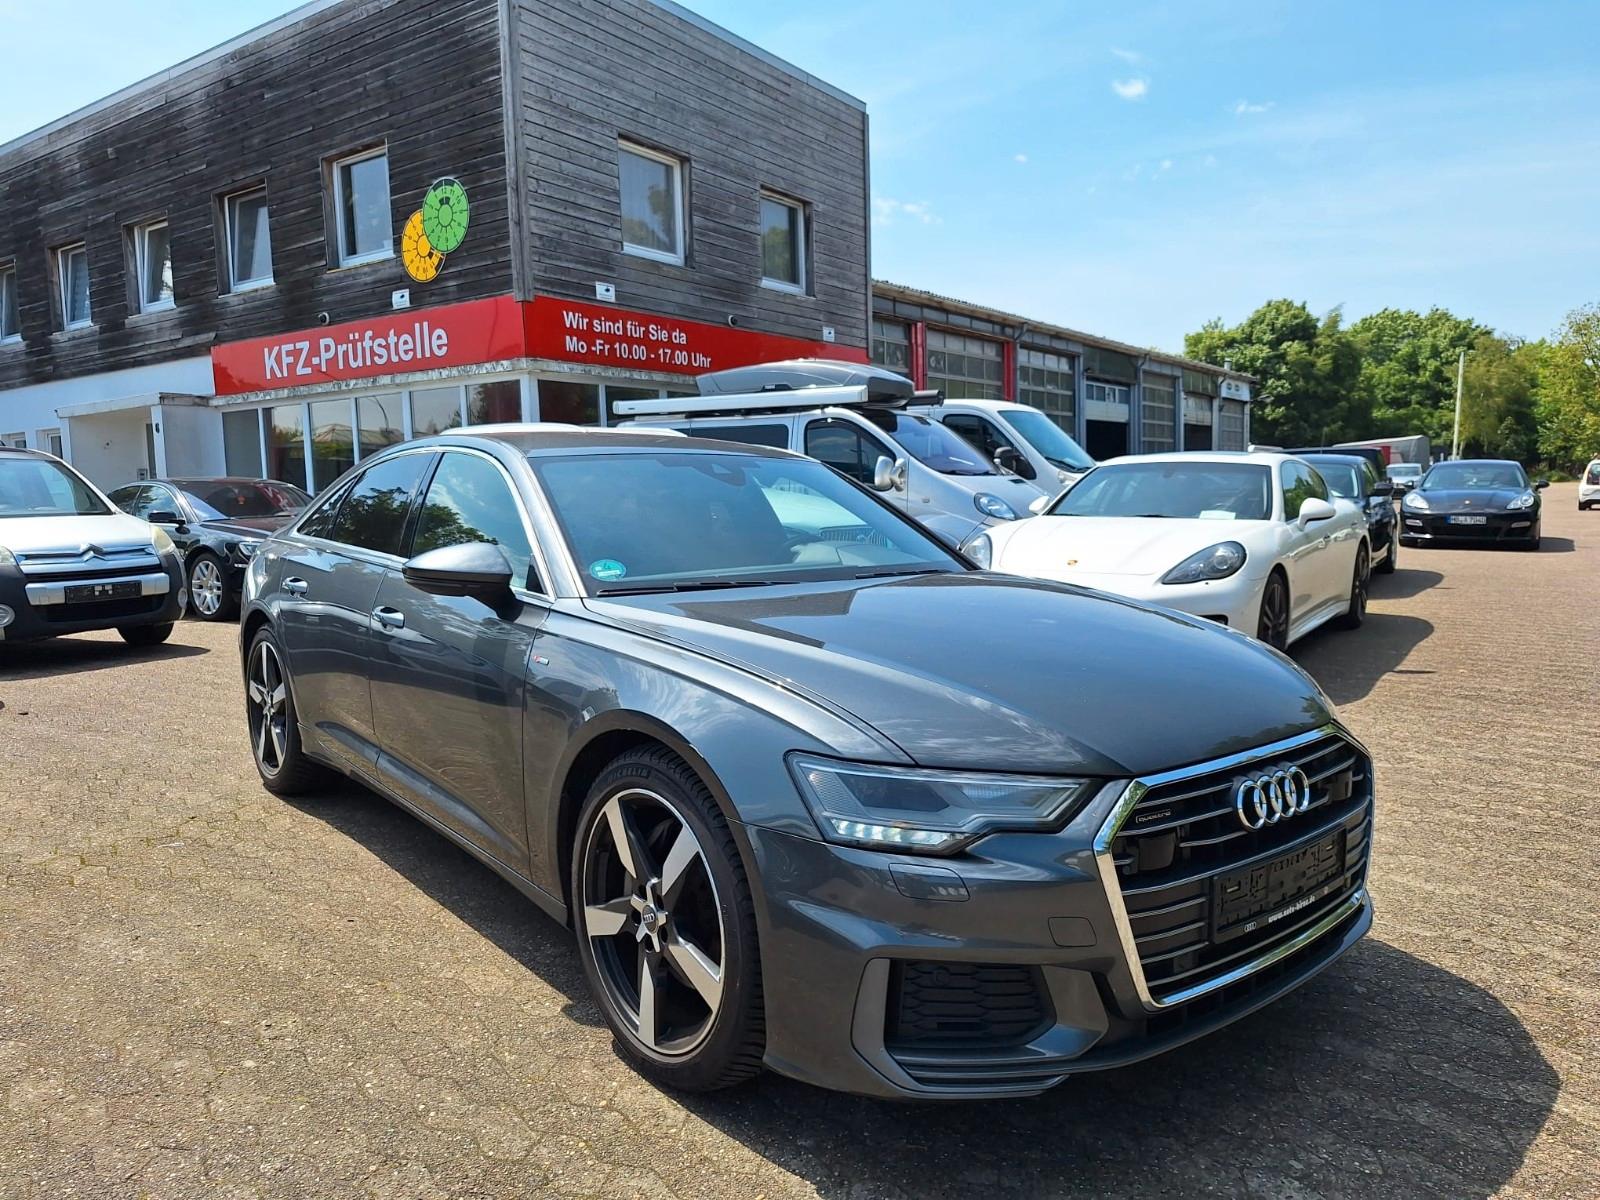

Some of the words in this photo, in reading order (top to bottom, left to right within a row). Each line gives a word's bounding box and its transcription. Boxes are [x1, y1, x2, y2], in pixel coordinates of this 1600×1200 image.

[563, 310, 589, 330] Wir
[593, 316, 623, 336] sind
[627, 320, 646, 338] für
[649, 324, 669, 342] Sie
[672, 328, 687, 345] da
[264, 321, 448, 380] KFZ-Prüfstelle
[565, 335, 587, 354] Mo
[614, 342, 647, 361] 10.00
[658, 348, 688, 366] 17.00
[691, 352, 711, 368] Uhr
[1138, 811, 1171, 822] quattro
